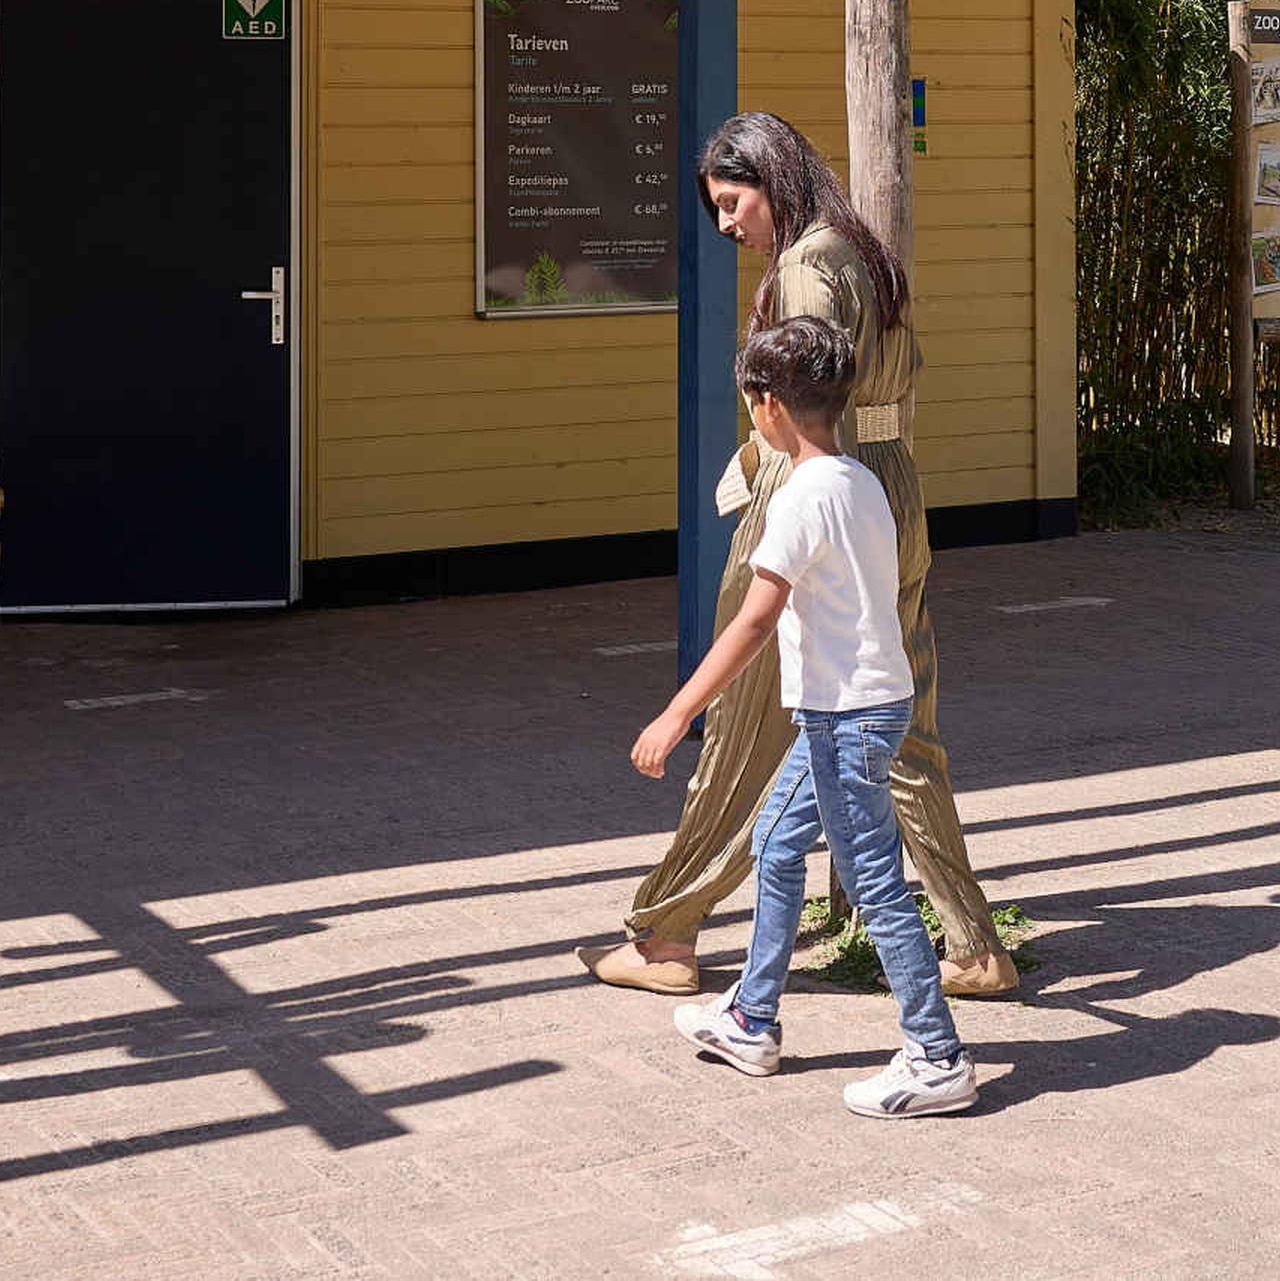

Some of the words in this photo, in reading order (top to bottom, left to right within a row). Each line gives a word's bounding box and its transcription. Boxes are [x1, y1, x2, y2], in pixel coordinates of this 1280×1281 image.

[231, 20, 277, 35] AED
[507, 34, 569, 51] Tarieven
[508, 83, 551, 94] Kinderen
[573, 84, 581, 94] 2
[631, 84, 668, 94] GRATIS
[508, 113, 552, 126] Dagkaart
[508, 144, 553, 156] Parkeren
[508, 175, 569, 188] Expeditiepas
[508, 206, 601, 217] Combi-abonnement
